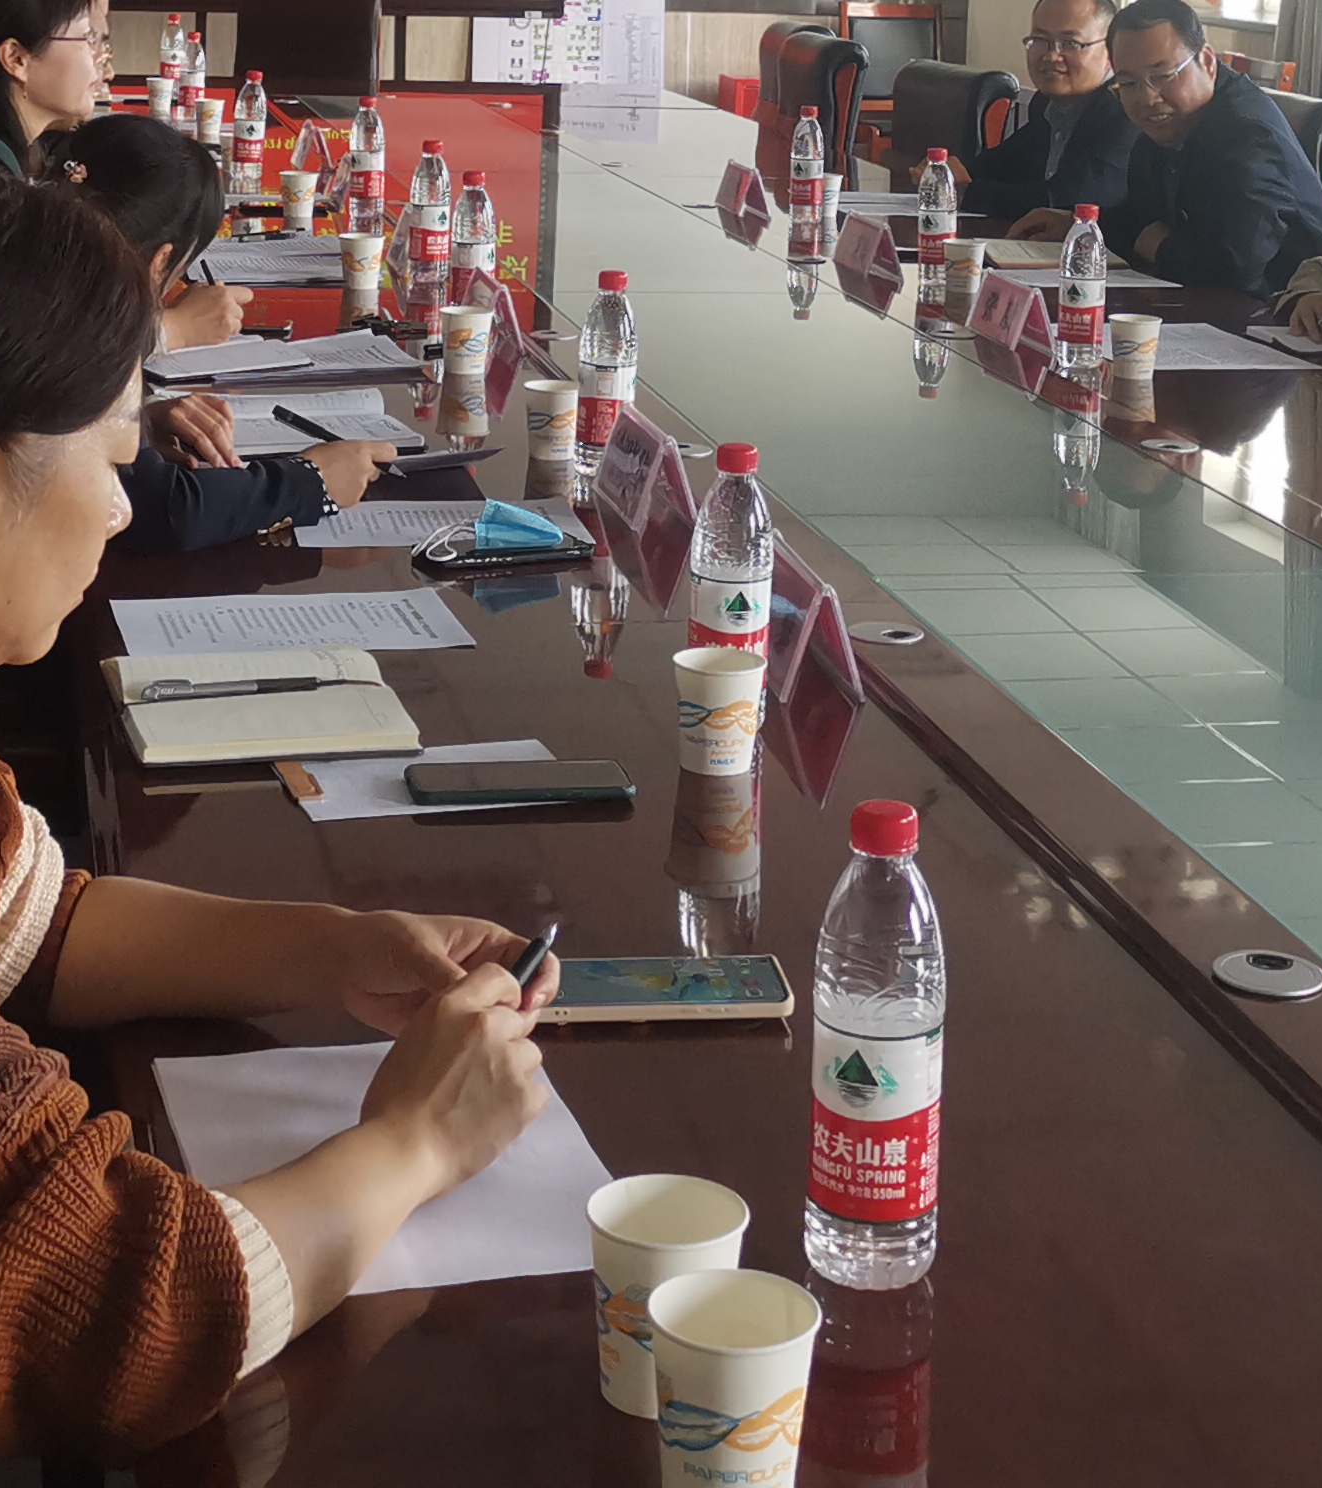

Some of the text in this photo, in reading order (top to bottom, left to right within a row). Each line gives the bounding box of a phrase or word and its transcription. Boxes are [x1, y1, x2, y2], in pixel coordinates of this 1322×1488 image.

[813, 1120, 908, 1168] 农夫山泉
[856, 1169, 906, 1185] SPRING
